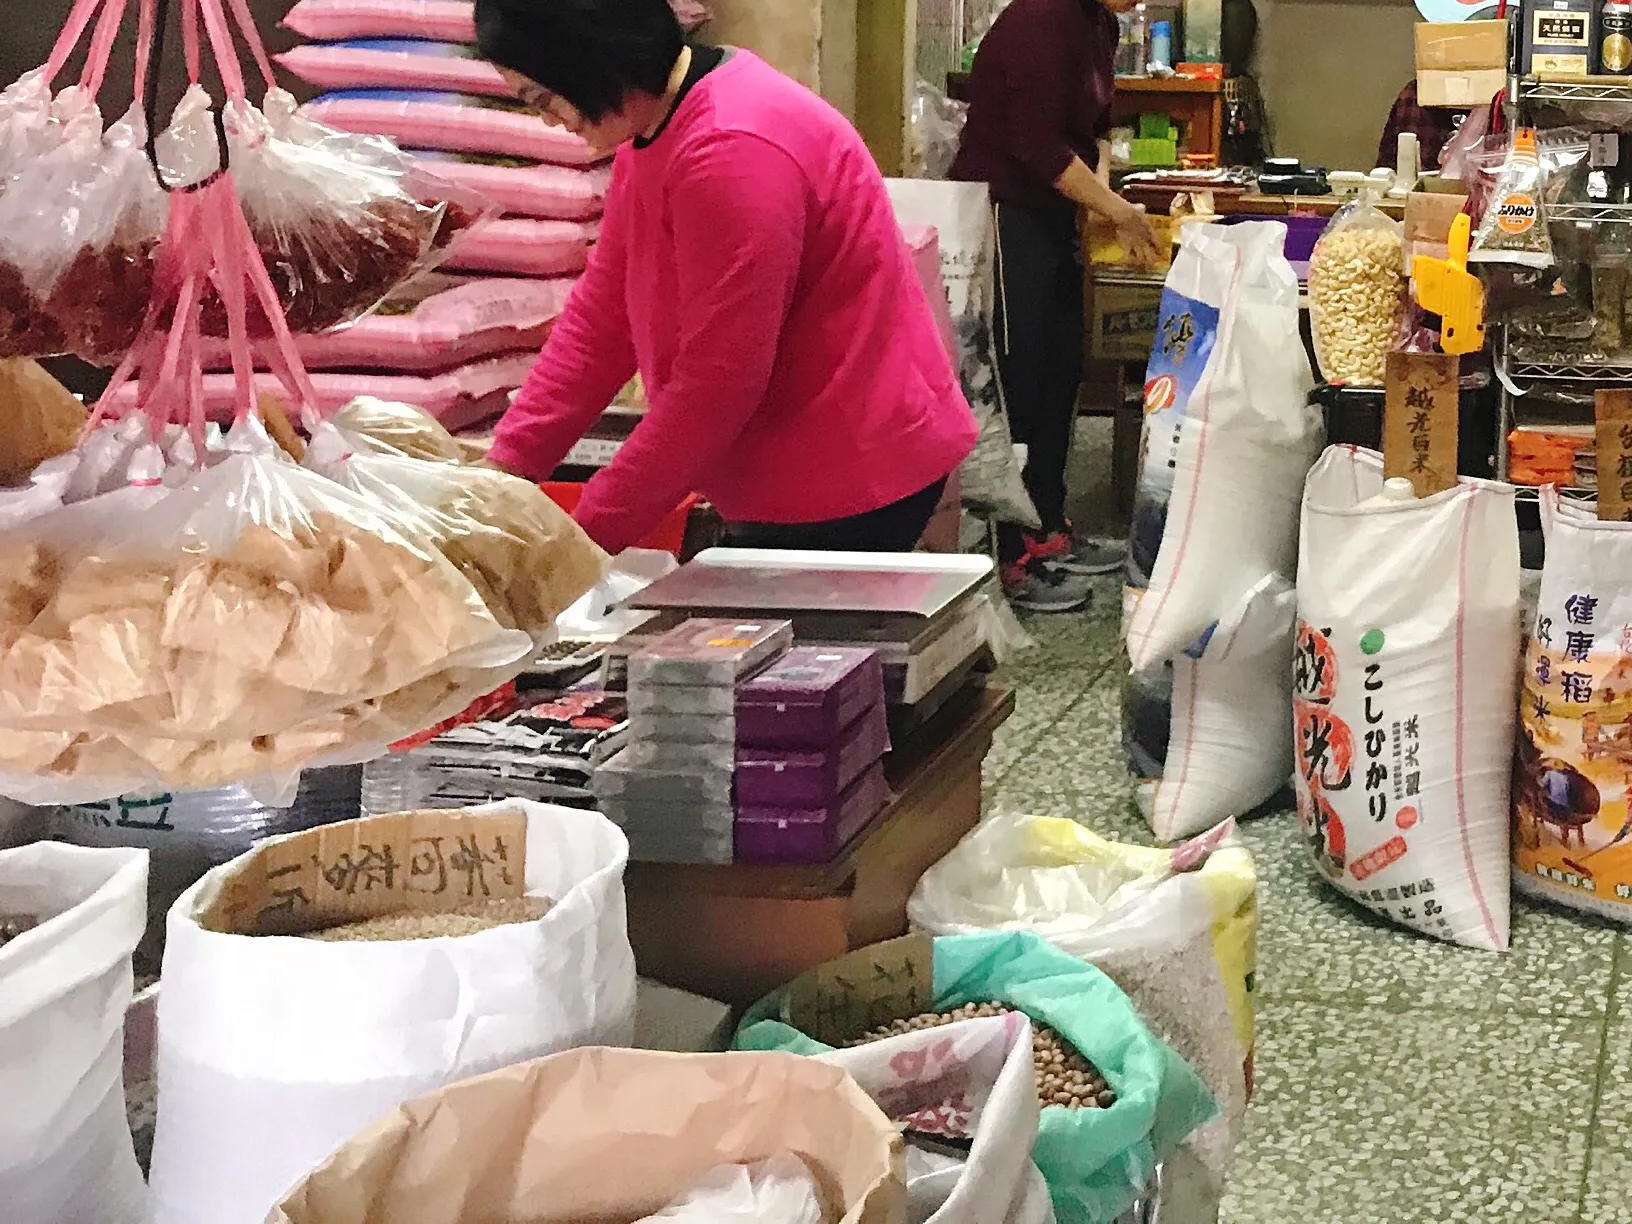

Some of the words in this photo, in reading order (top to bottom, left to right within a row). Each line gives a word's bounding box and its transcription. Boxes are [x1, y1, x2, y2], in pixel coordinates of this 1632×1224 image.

[1562, 593, 1599, 704] 健康稻
[1364, 663, 1389, 823] こしひかり
